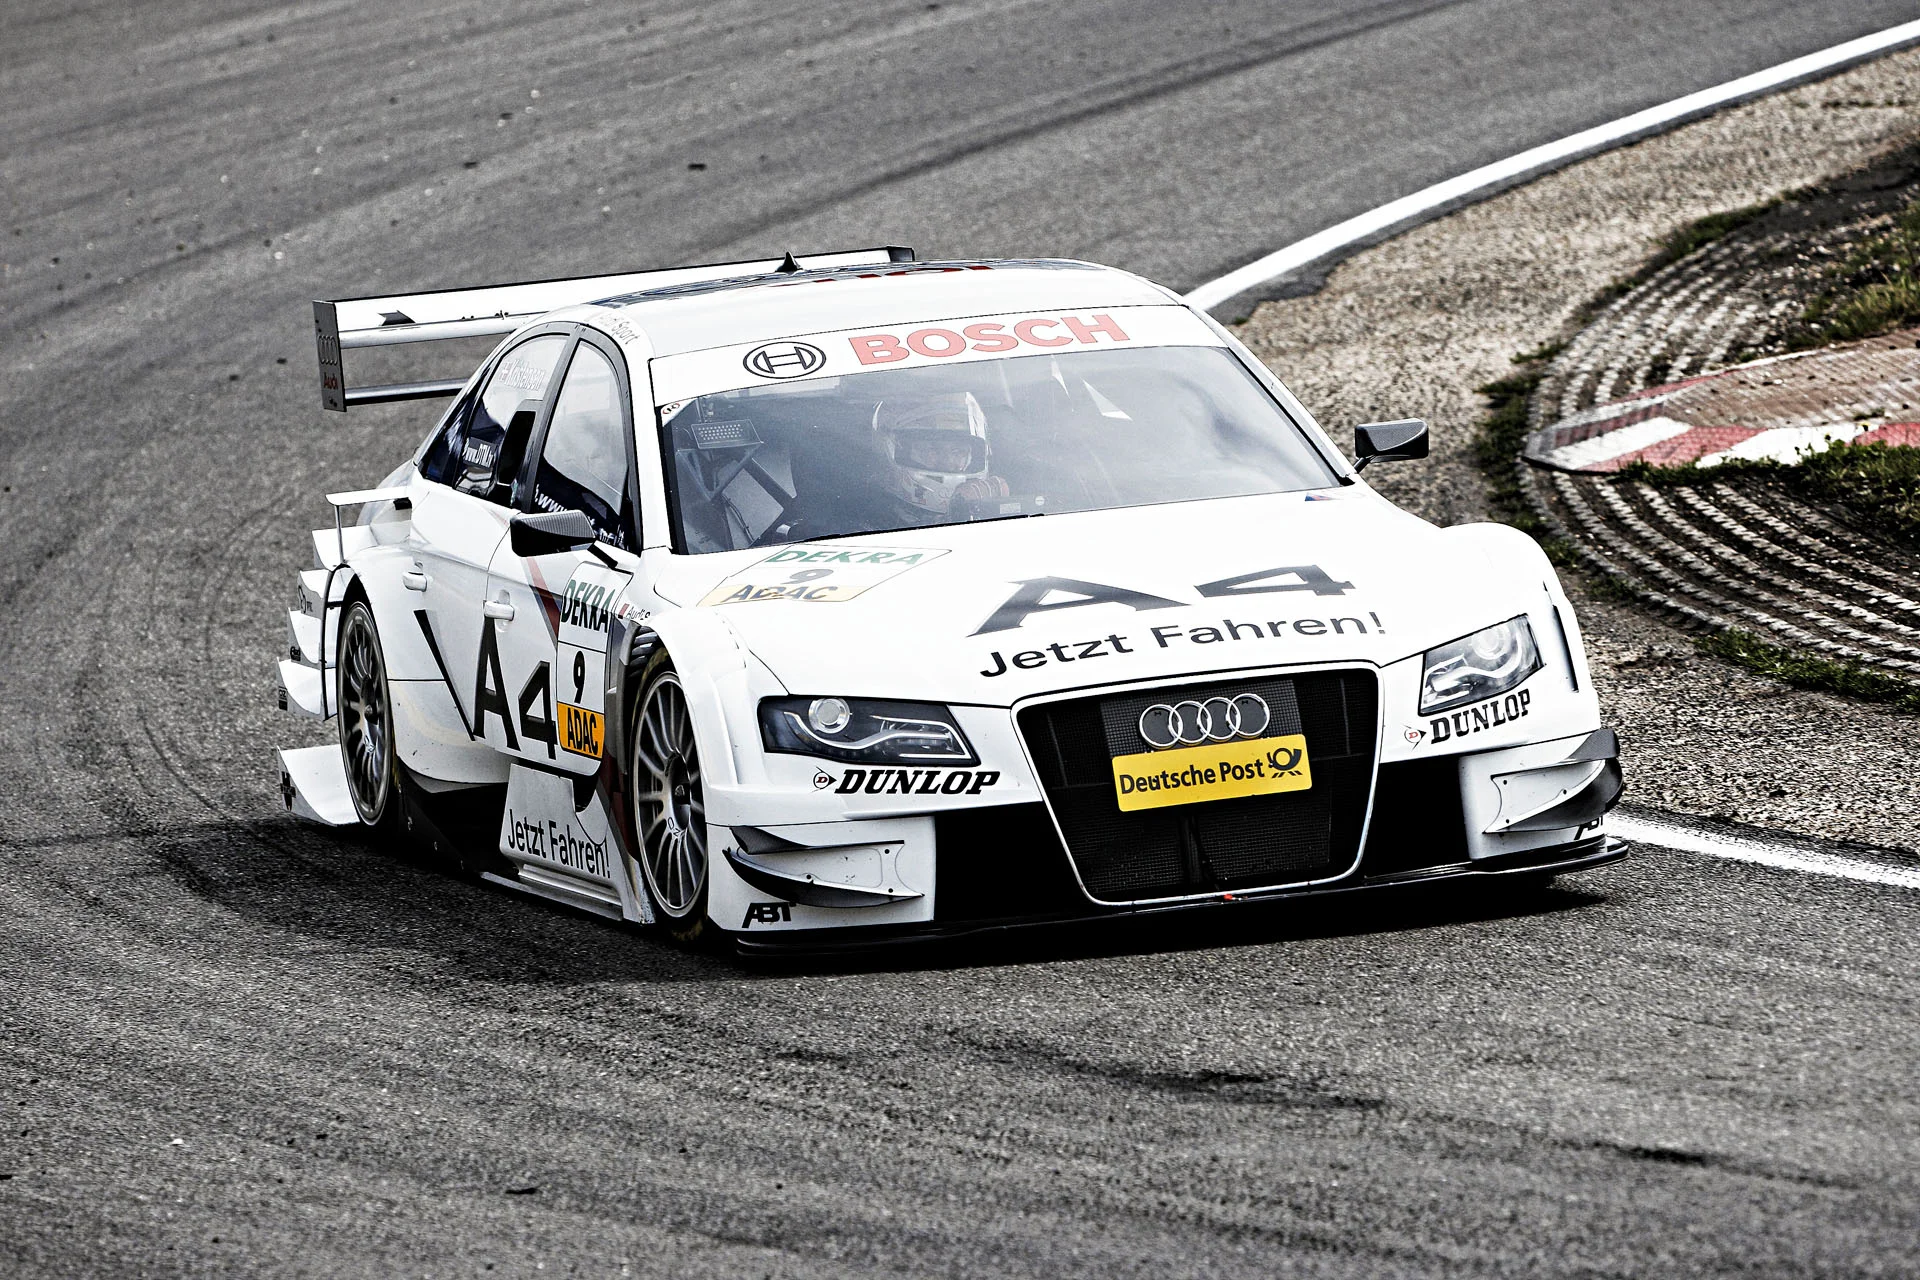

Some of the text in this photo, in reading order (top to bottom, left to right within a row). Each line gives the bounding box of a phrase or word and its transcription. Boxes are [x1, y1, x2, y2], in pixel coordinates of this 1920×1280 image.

[847, 313, 1130, 367] BOSCH
[764, 550, 925, 565] DEKRA
[779, 568, 834, 585] 9
[561, 578, 615, 633] DEKRA
[720, 584, 838, 603] ADAC
[979, 611, 1386, 678] Jetzt Fahren!
[473, 616, 558, 760] A4
[573, 650, 586, 704] 9
[567, 707, 599, 756] ADAC
[1430, 689, 1531, 744] DUNLOP
[834, 769, 1001, 795] DUNLOP
[1119, 759, 1265, 794] Deutsche Post
[508, 808, 611, 879] Jetzt Fahren!
[741, 901, 792, 929] ABT
